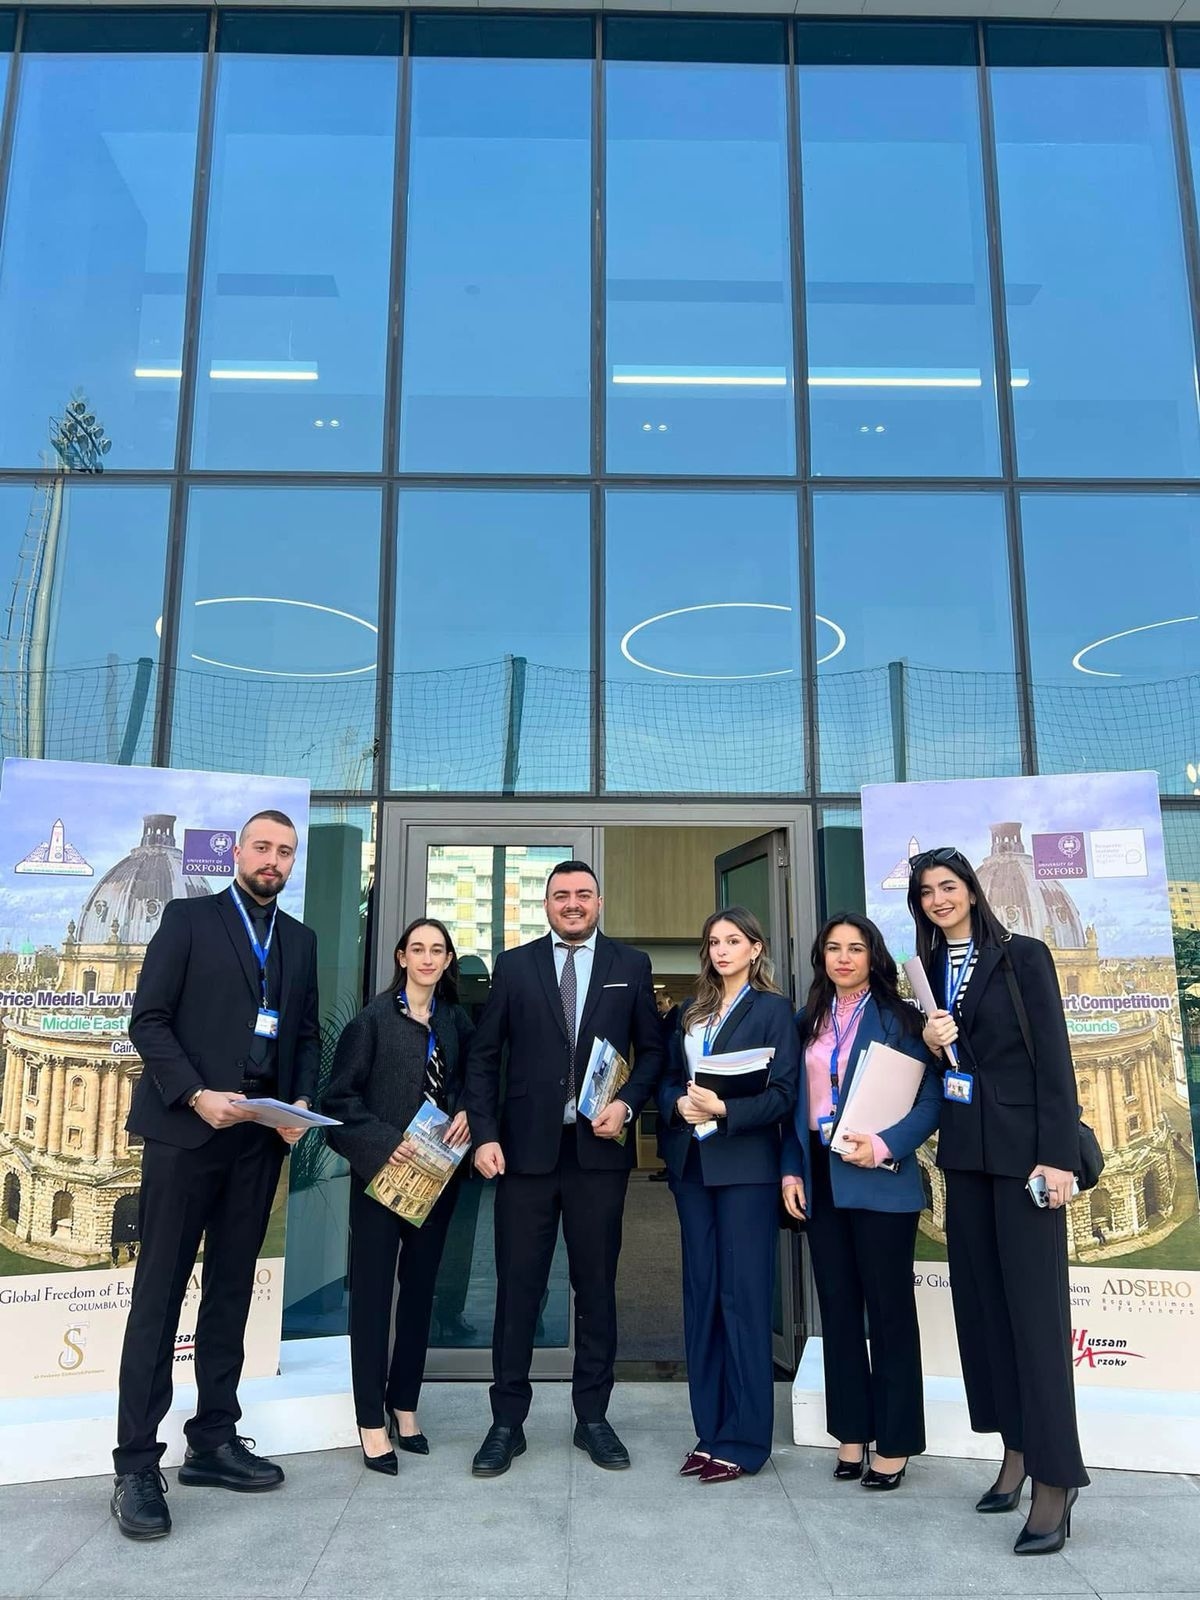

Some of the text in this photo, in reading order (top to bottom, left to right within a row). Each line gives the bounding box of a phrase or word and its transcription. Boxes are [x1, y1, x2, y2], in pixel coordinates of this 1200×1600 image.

[186, 864, 231, 873] OXFORD
[1038, 867, 1084, 876] OXFORD
[37, 992, 84, 1006] Media
[89, 992, 121, 1006] Law
[1081, 995, 1170, 1012] Competition
[42, 1017, 124, 1030] Middle East
[1066, 1020, 1118, 1032] Rounds
[0, 1288, 41, 1304] Global
[45, 1286, 95, 1301] Freedom
[100, 1283, 113, 1297] of
[1102, 1278, 1191, 1298] ADSERO
[68, 1301, 117, 1312] COLUMBIA
[1071, 1329, 1127, 1351] Hussam
[1075, 1347, 1127, 1368] Arzoky
